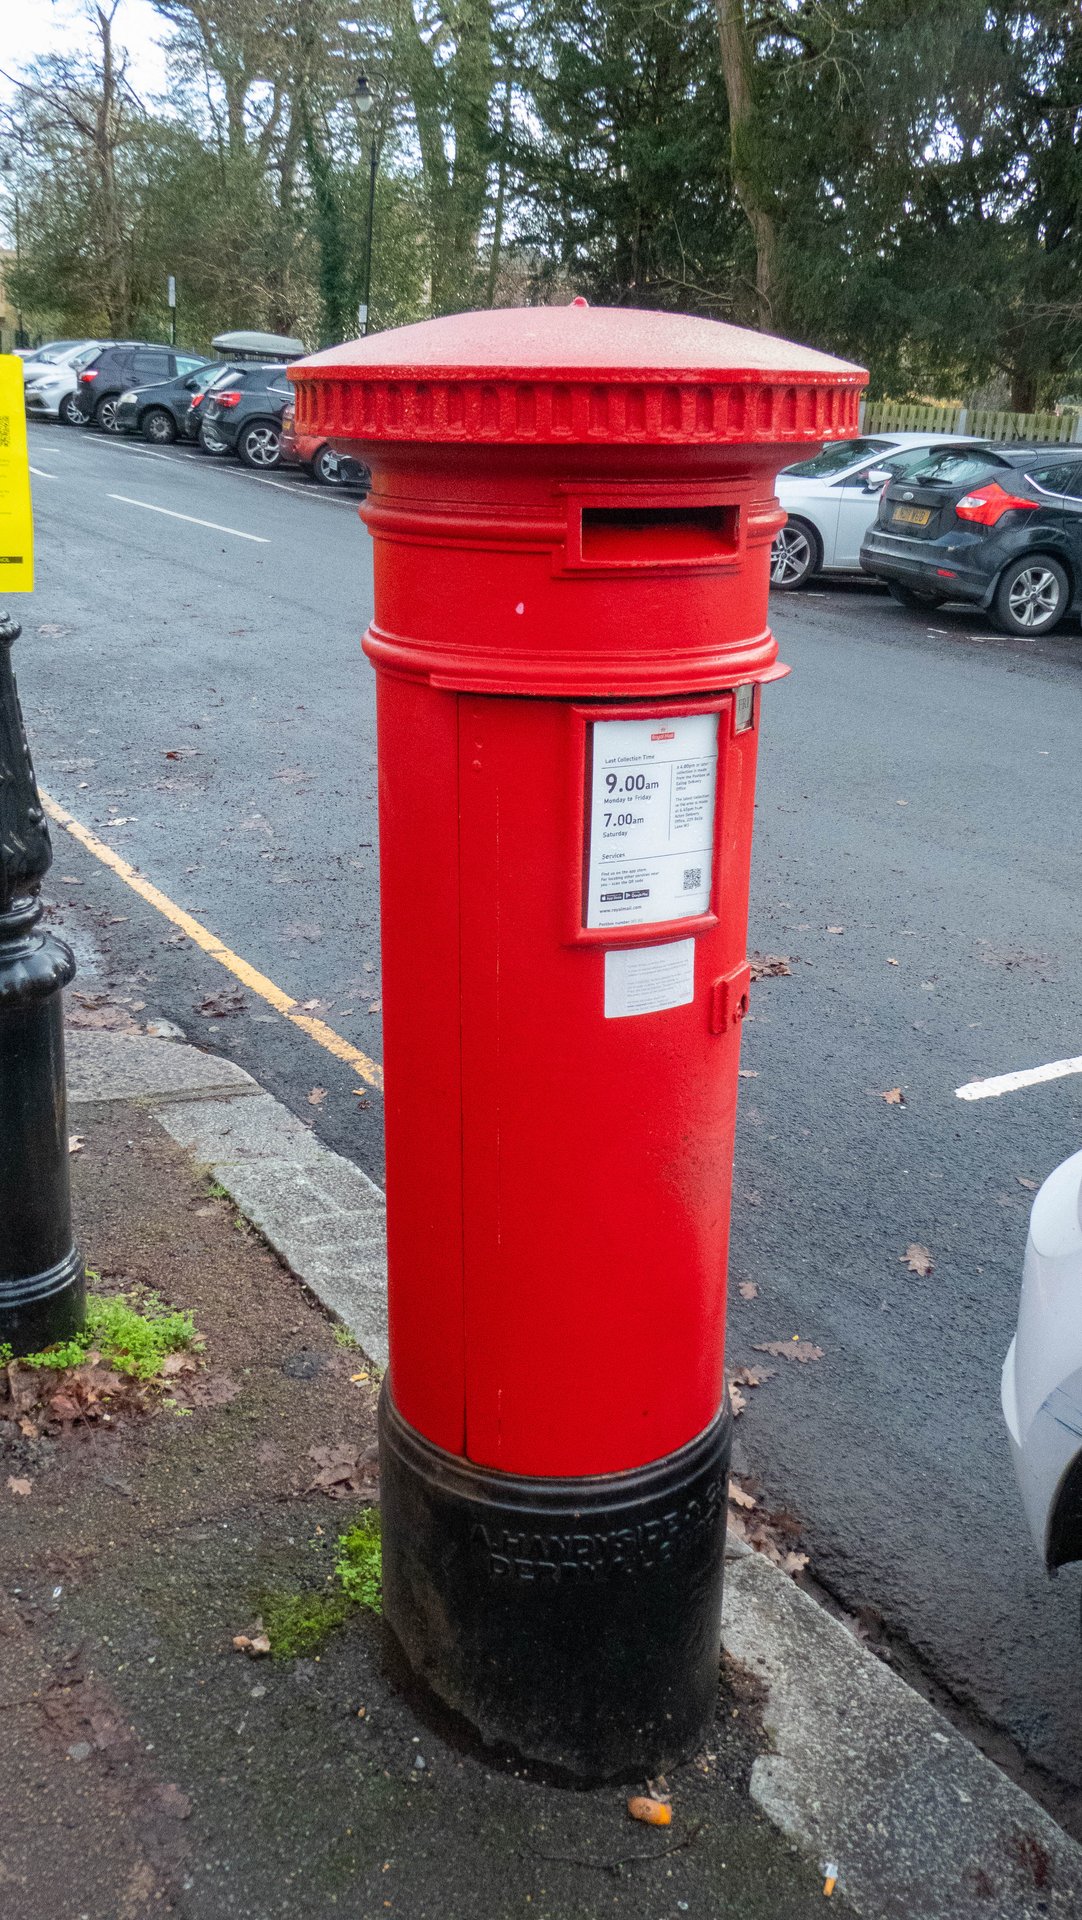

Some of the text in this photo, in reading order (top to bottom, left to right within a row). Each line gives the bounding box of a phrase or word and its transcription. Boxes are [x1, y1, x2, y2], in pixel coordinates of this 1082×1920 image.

[738, 697, 750, 711] FRI
[605, 773, 659, 794] 9.00am
[604, 813, 644, 827] 7.00am
